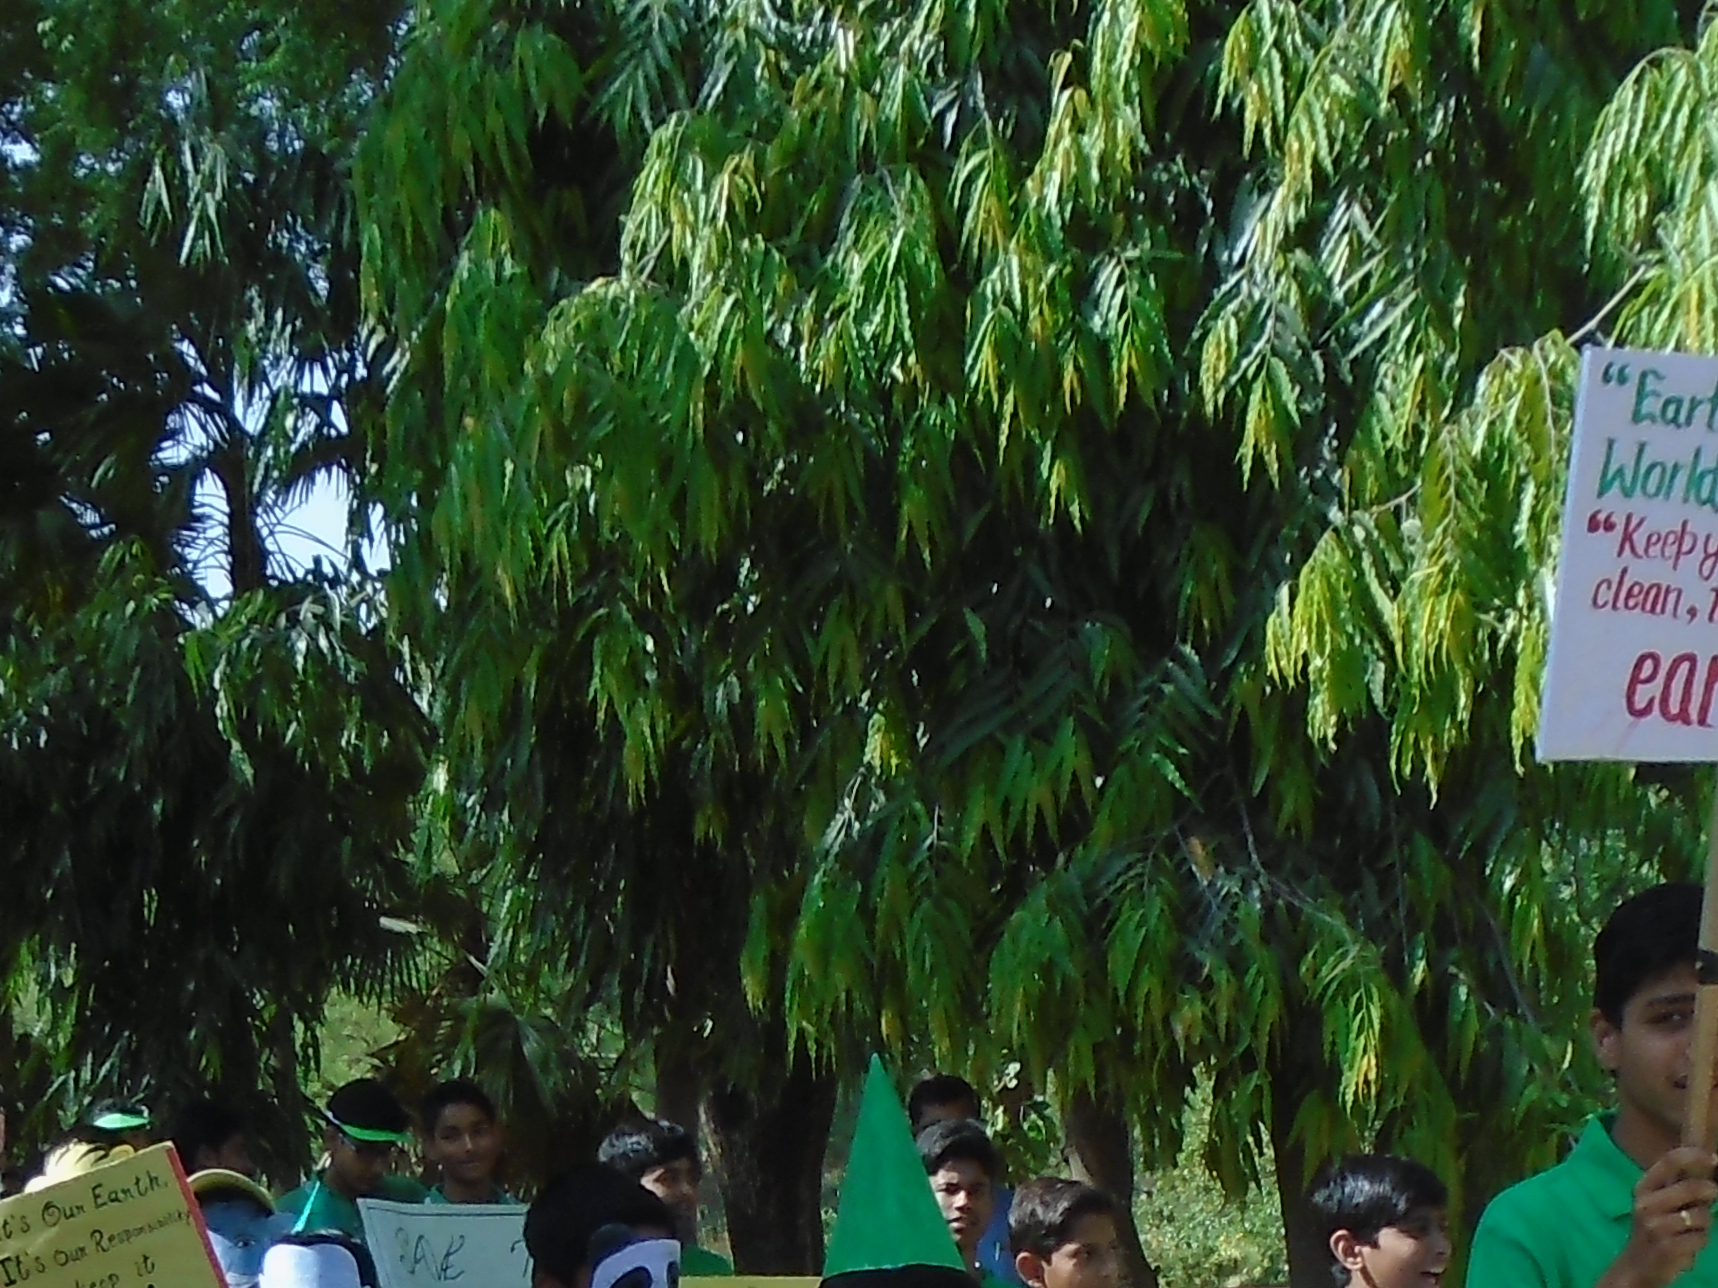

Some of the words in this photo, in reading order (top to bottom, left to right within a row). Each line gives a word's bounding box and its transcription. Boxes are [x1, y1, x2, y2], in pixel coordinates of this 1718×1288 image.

[1591, 568, 1699, 625] clean,
[41, 1200, 86, 1228] Our
[135, 1254, 155, 1277] it
